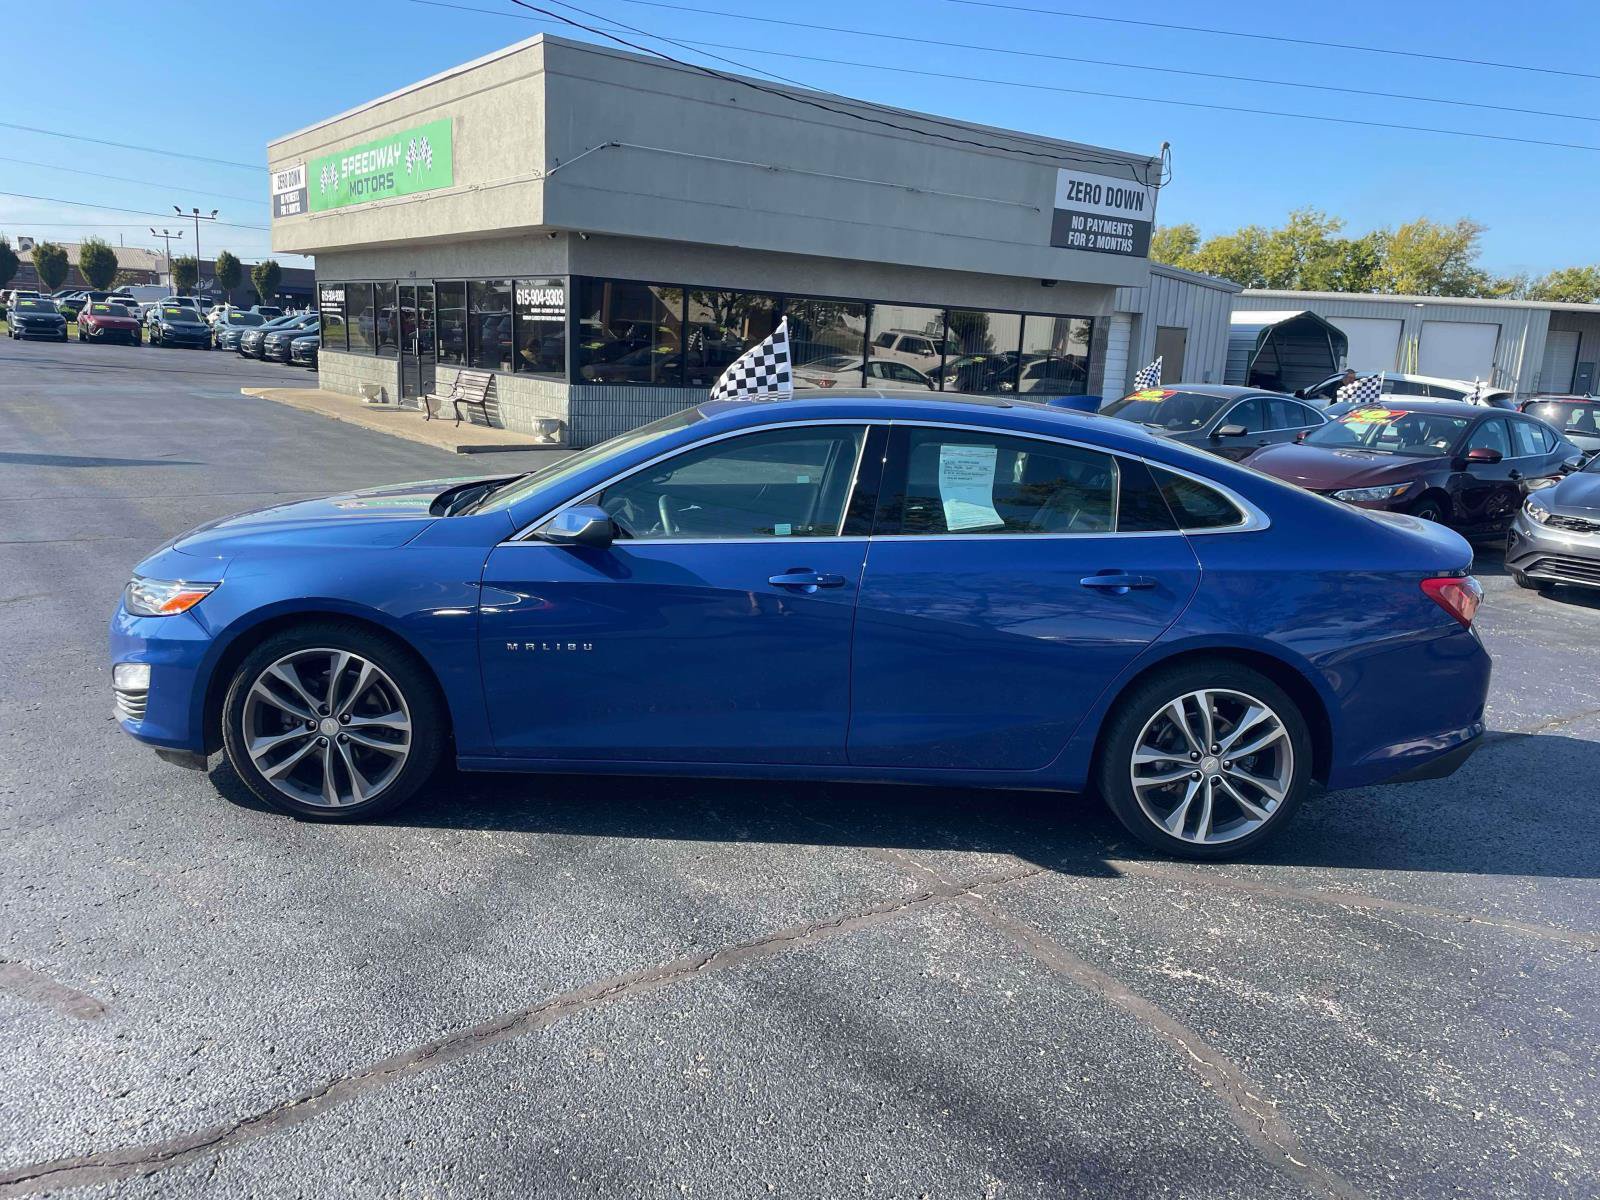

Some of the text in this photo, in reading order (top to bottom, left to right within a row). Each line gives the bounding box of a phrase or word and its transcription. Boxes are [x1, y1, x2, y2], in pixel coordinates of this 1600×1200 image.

[341, 143, 402, 178] SPEEDWAY
[349, 172, 394, 197] MOTORS
[1066, 180, 1144, 211] ZERO DOWN
[1071, 216, 1133, 237] NO PAYMENTS
[1068, 231, 1133, 252] FOR 2 MONTHS
[516, 288, 564, 306] 615-904-9303
[506, 642, 593, 651] MALIBU
